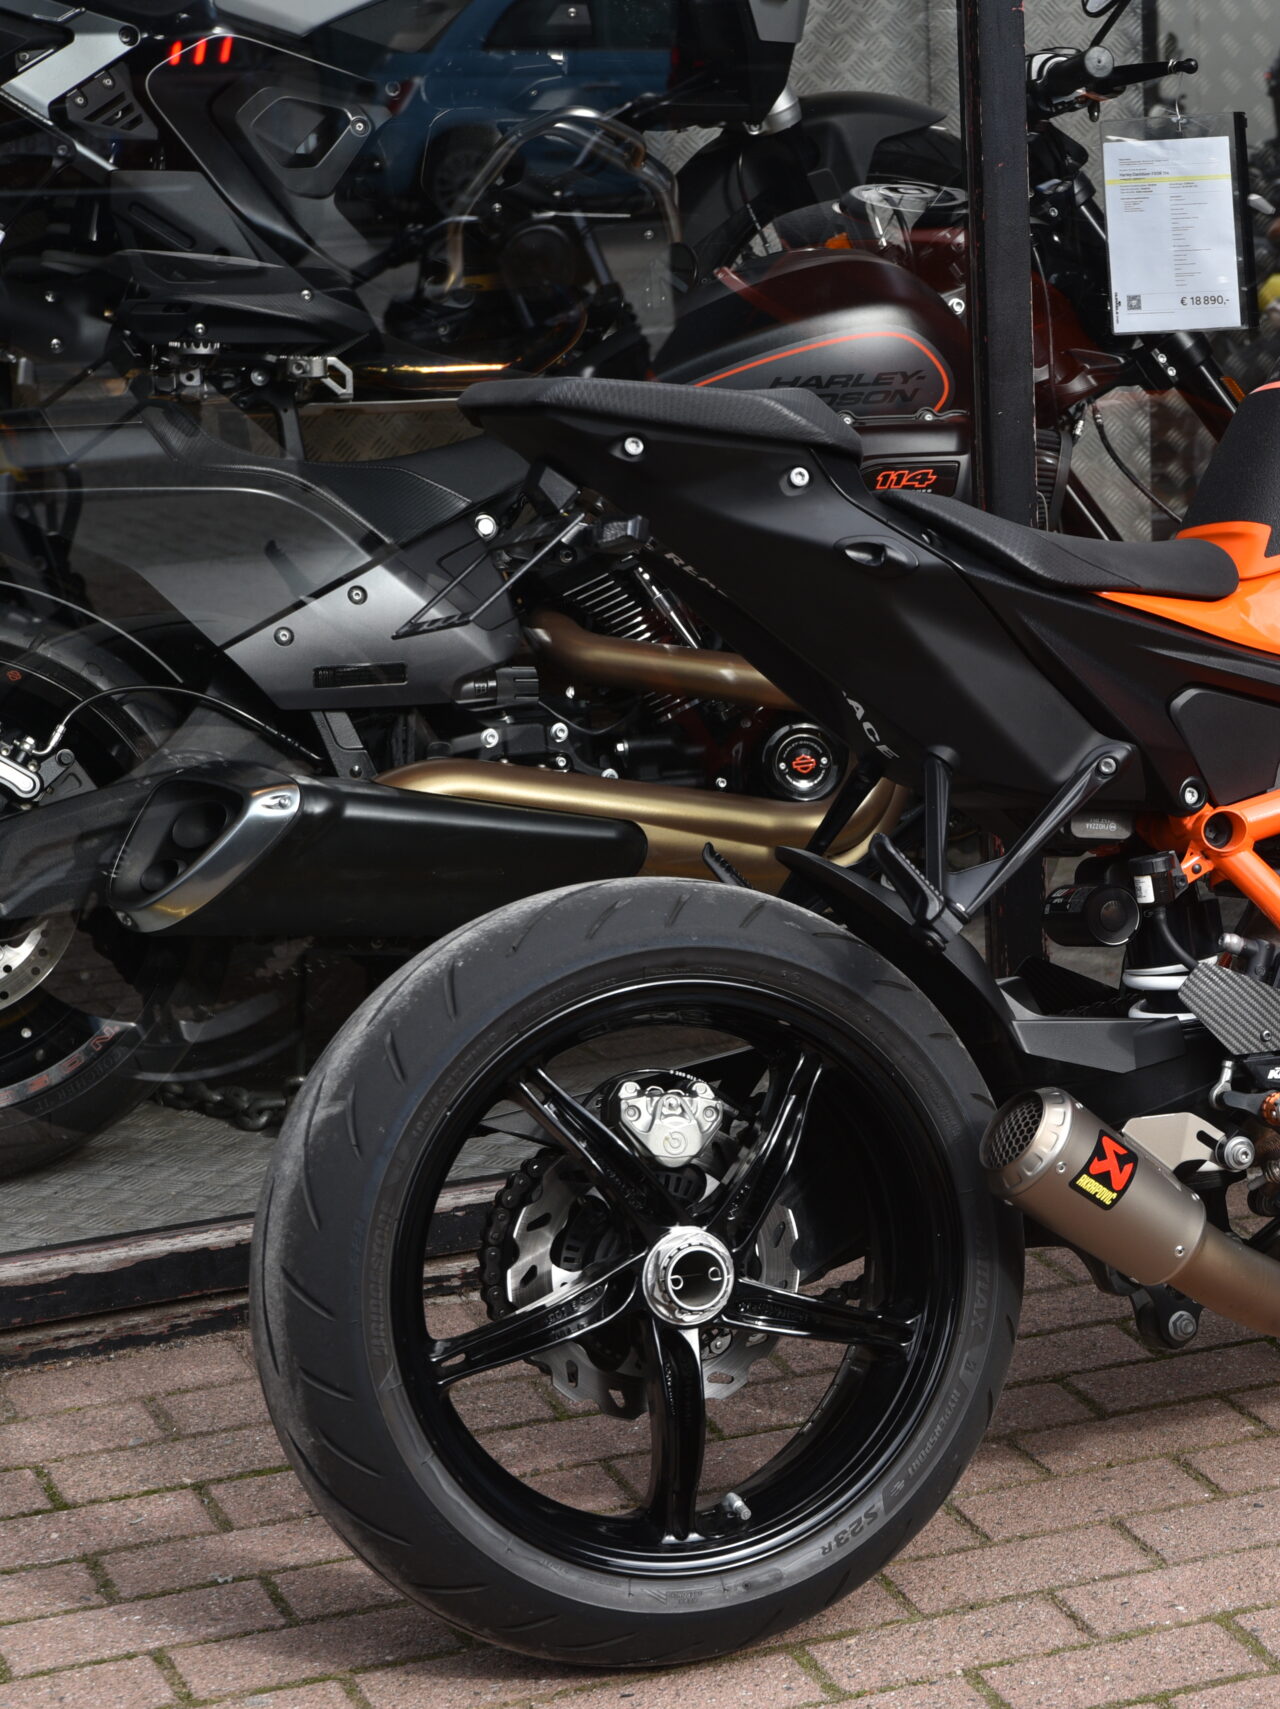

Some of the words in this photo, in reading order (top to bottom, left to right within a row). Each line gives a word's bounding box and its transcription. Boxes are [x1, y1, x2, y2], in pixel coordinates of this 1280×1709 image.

[1180, 296, 1188, 306] €
[769, 369, 928, 389] HARLEY-
[817, 387, 920, 407] DSON
[876, 469, 937, 490] 114
[842, 690, 900, 759] ACE
[907, 1388, 962, 1480] HYPERSPORT
[821, 1504, 880, 1557] S23R
